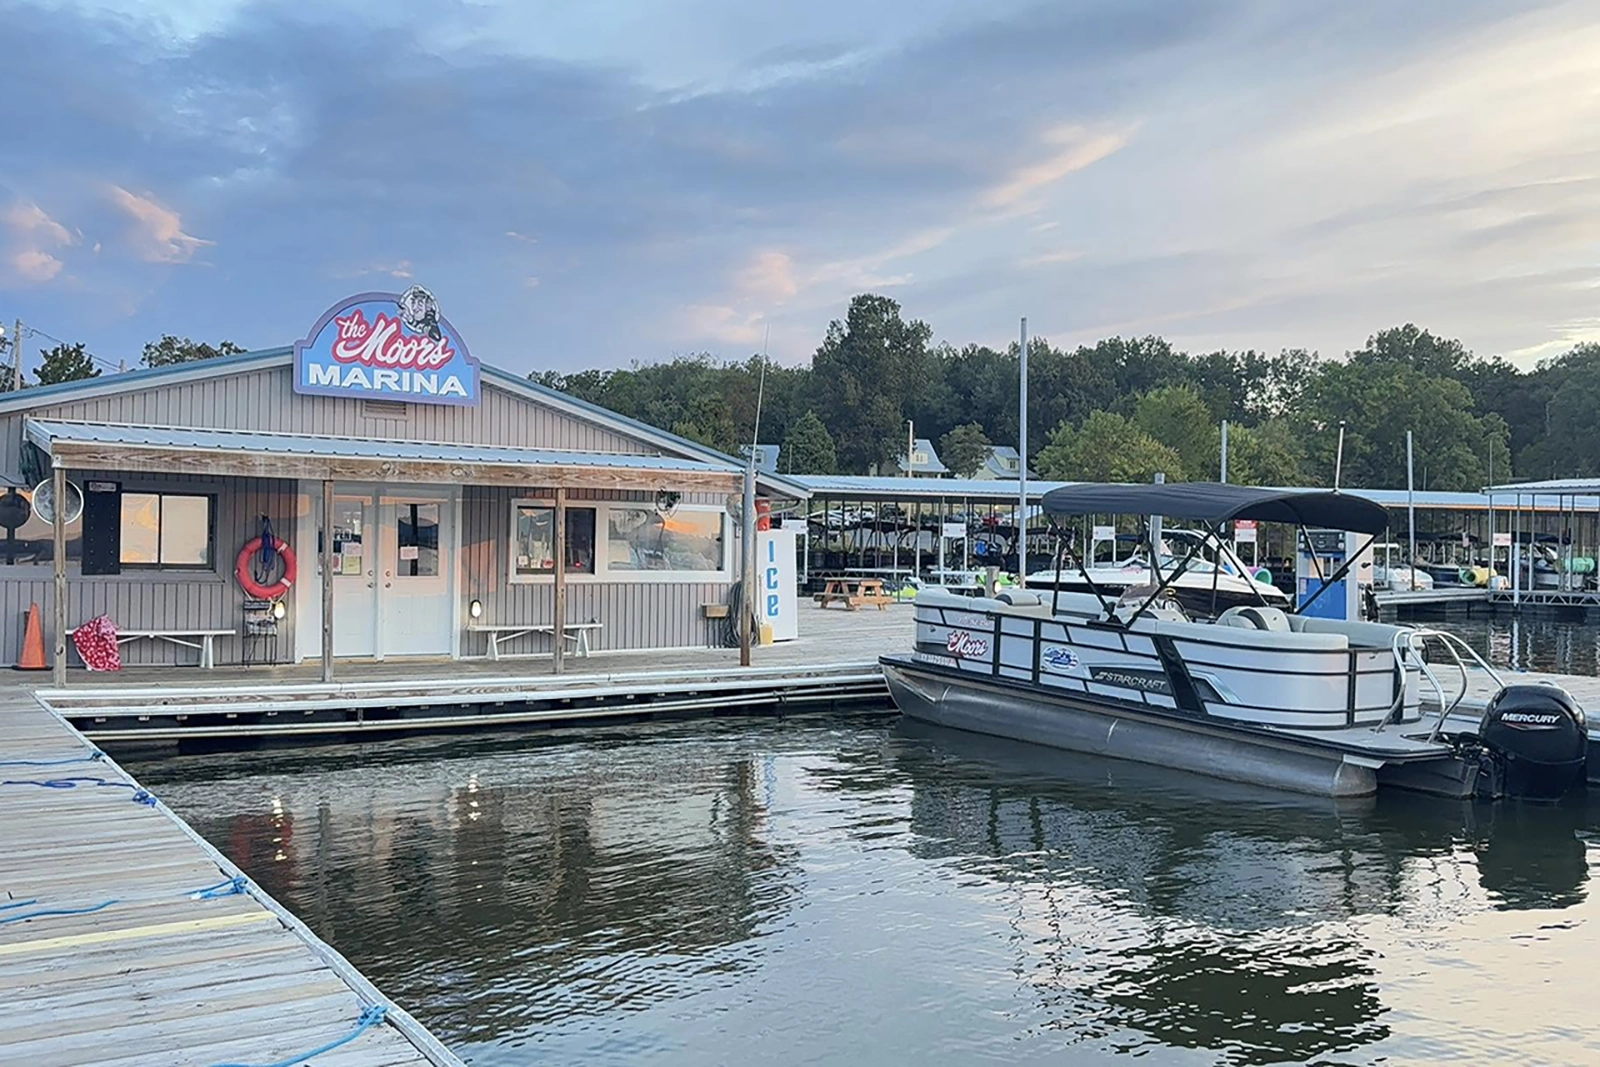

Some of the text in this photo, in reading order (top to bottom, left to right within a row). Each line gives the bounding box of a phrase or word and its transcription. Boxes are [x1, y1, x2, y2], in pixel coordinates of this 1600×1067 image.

[336, 314, 452, 365] the Moors
[308, 363, 468, 397] MARINA
[947, 633, 988, 656] Moors
[1106, 672, 1167, 691] STARCRAFT
[1501, 712, 1560, 723] MERCURY
